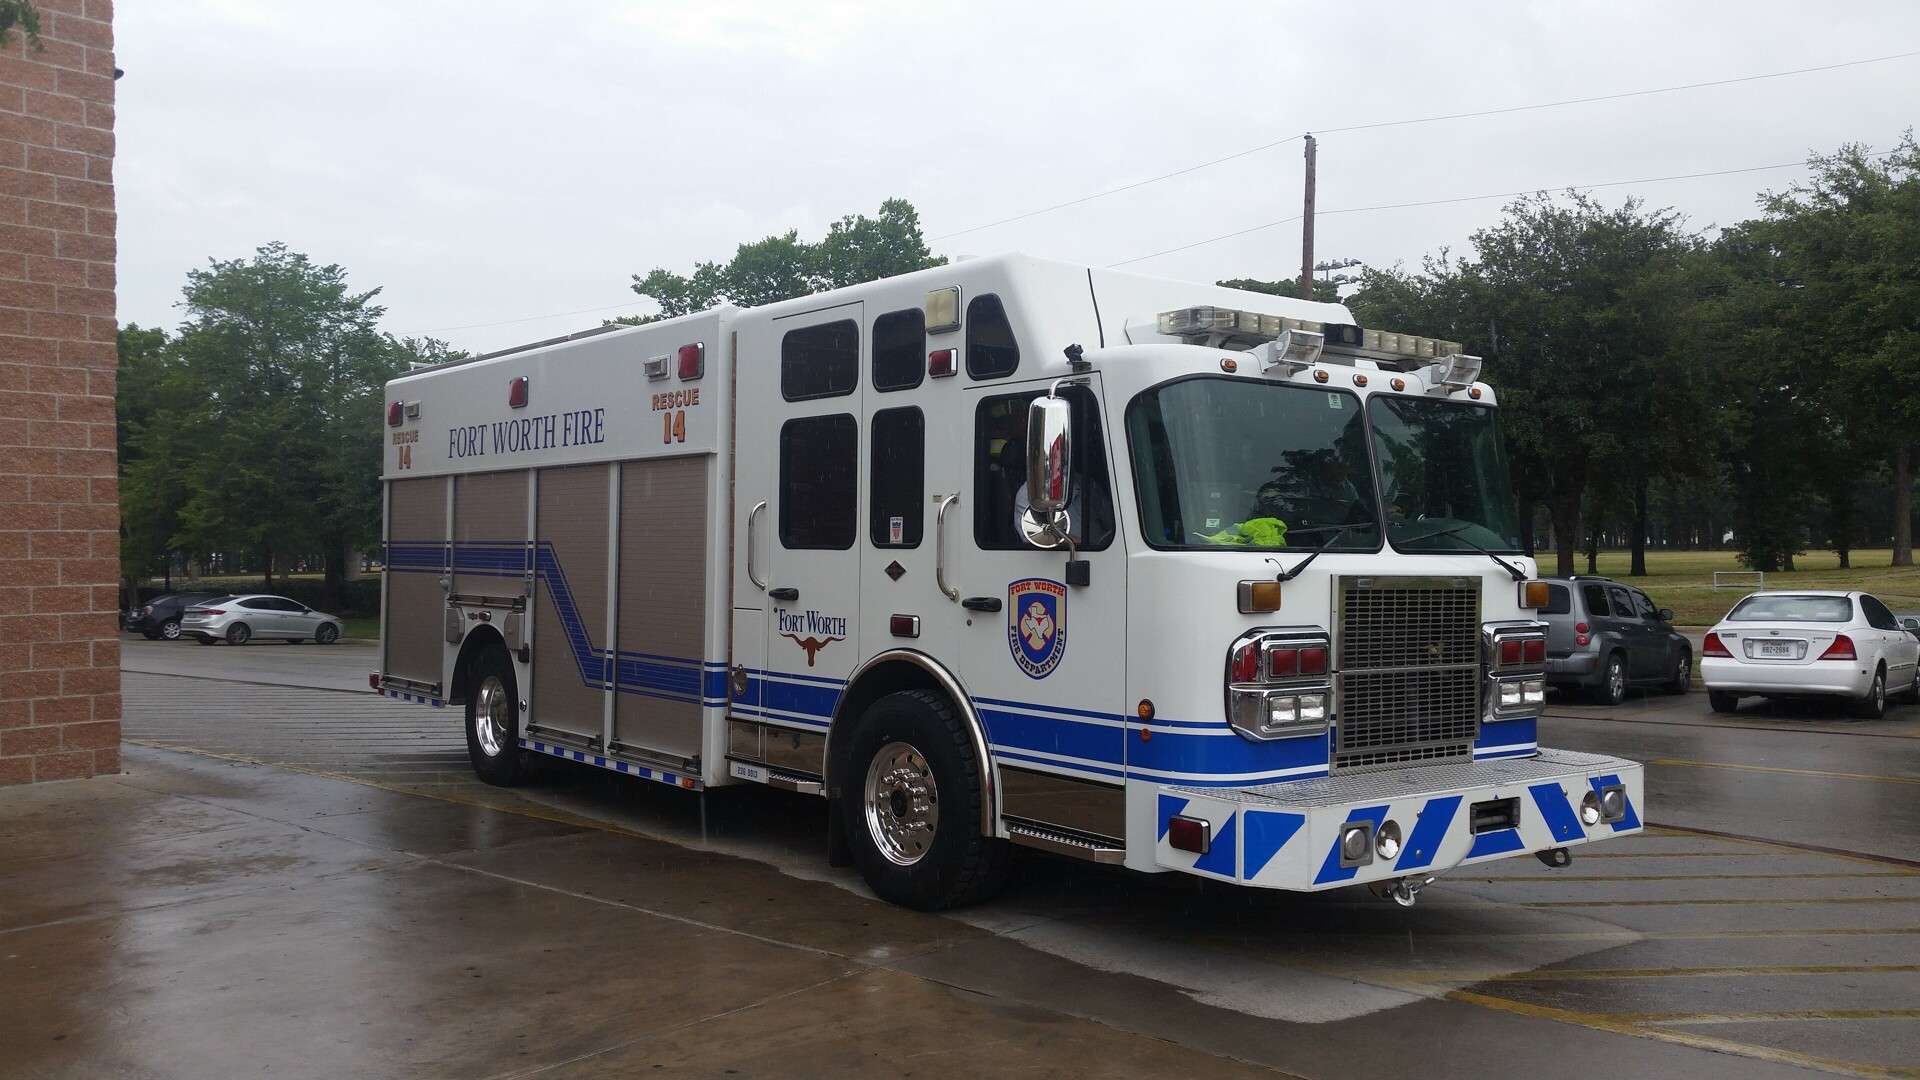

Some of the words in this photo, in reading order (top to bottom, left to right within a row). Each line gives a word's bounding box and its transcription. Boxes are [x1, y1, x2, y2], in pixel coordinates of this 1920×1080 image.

[652, 387, 700, 411] RESCUE
[392, 430, 419, 446] RESCUE
[447, 424, 488, 459] FORT
[492, 414, 557, 455] WORTH
[562, 408, 605, 447] FIRE
[663, 410, 686, 444] 14
[399, 445, 411, 470] 14
[1011, 581, 1031, 595] FORT
[1034, 582, 1065, 597] WORTH
[779, 608, 804, 632] FORT
[806, 610, 847, 636] WORTH
[1011, 625, 1021, 655] FIRE
[1019, 628, 1064, 675] DEPARTMENT
